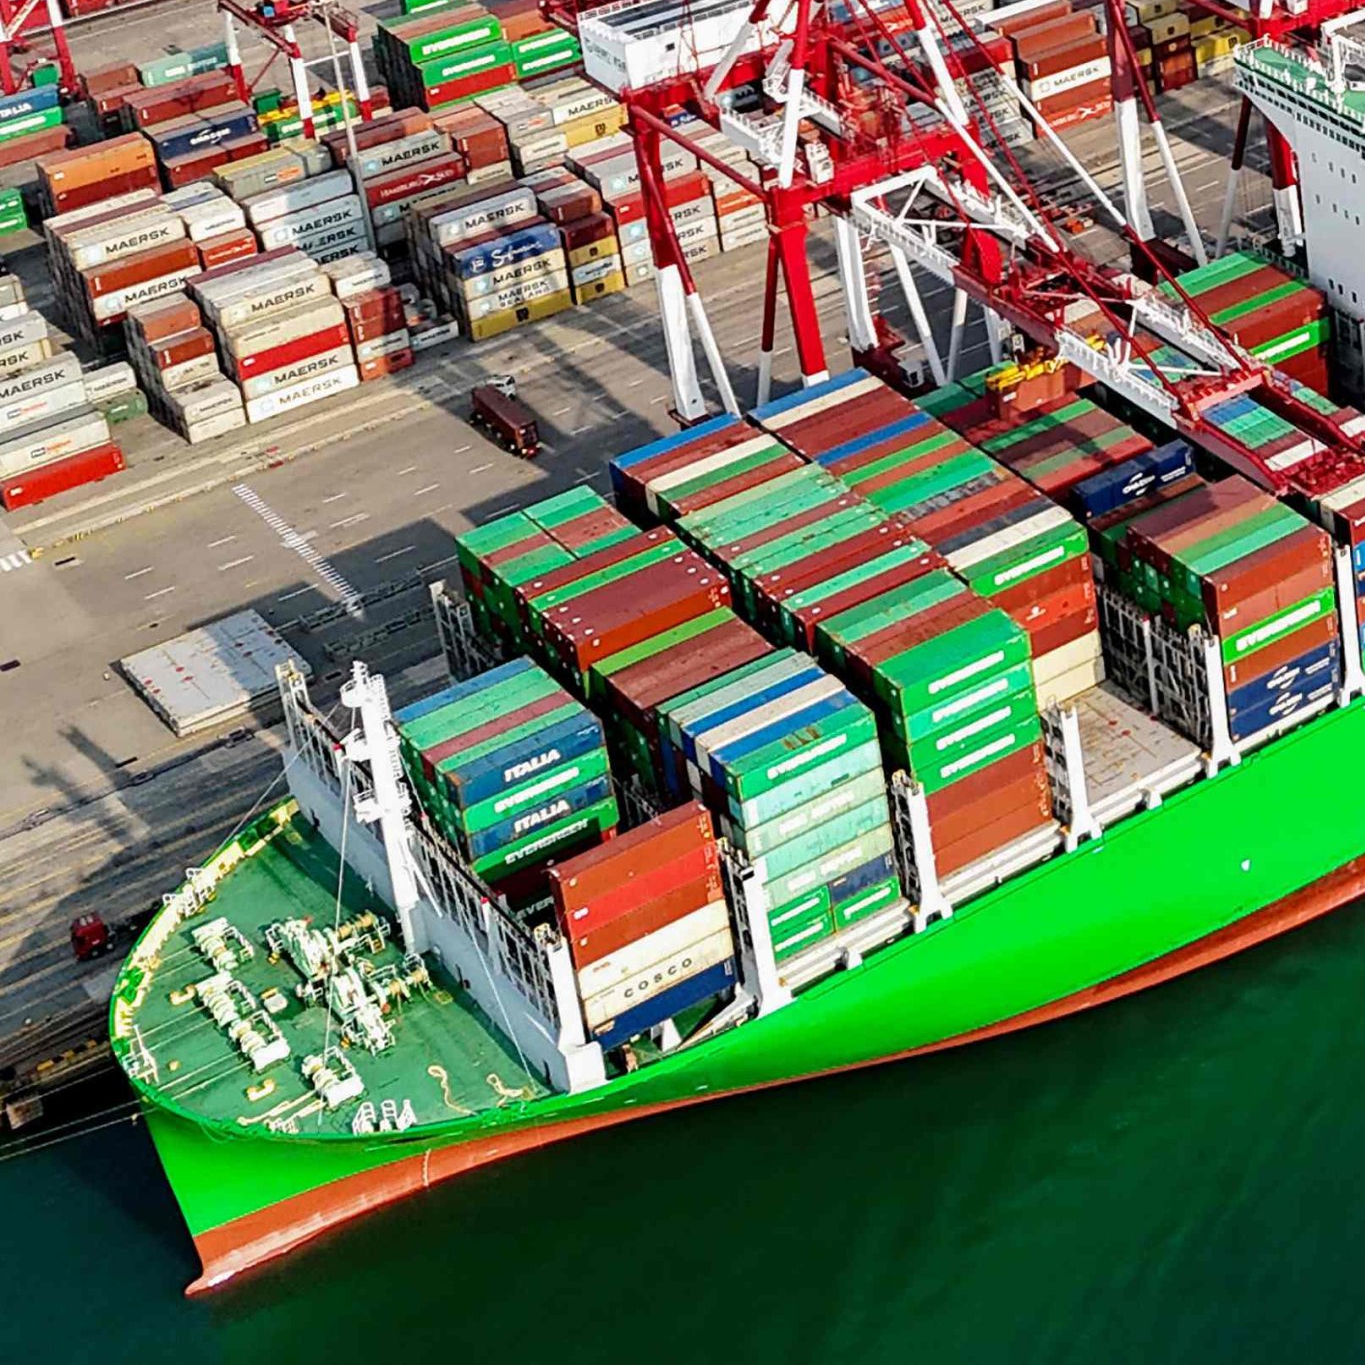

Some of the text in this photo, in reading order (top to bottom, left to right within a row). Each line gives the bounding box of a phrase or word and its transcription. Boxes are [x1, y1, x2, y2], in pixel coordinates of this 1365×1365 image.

[382, 141, 441, 167] MAERSK
[291, 209, 353, 235] MAERSK
[465, 203, 525, 229] MAERSK
[105, 227, 170, 255] MAERSK
[251, 283, 316, 313] MAERSK
[274, 354, 339, 385] MAERSK
[279, 375, 343, 405] MAERSK
[504, 748, 562, 783] ITALIA
[514, 798, 572, 834] ITALIA
[623, 957, 693, 999] COSCO
